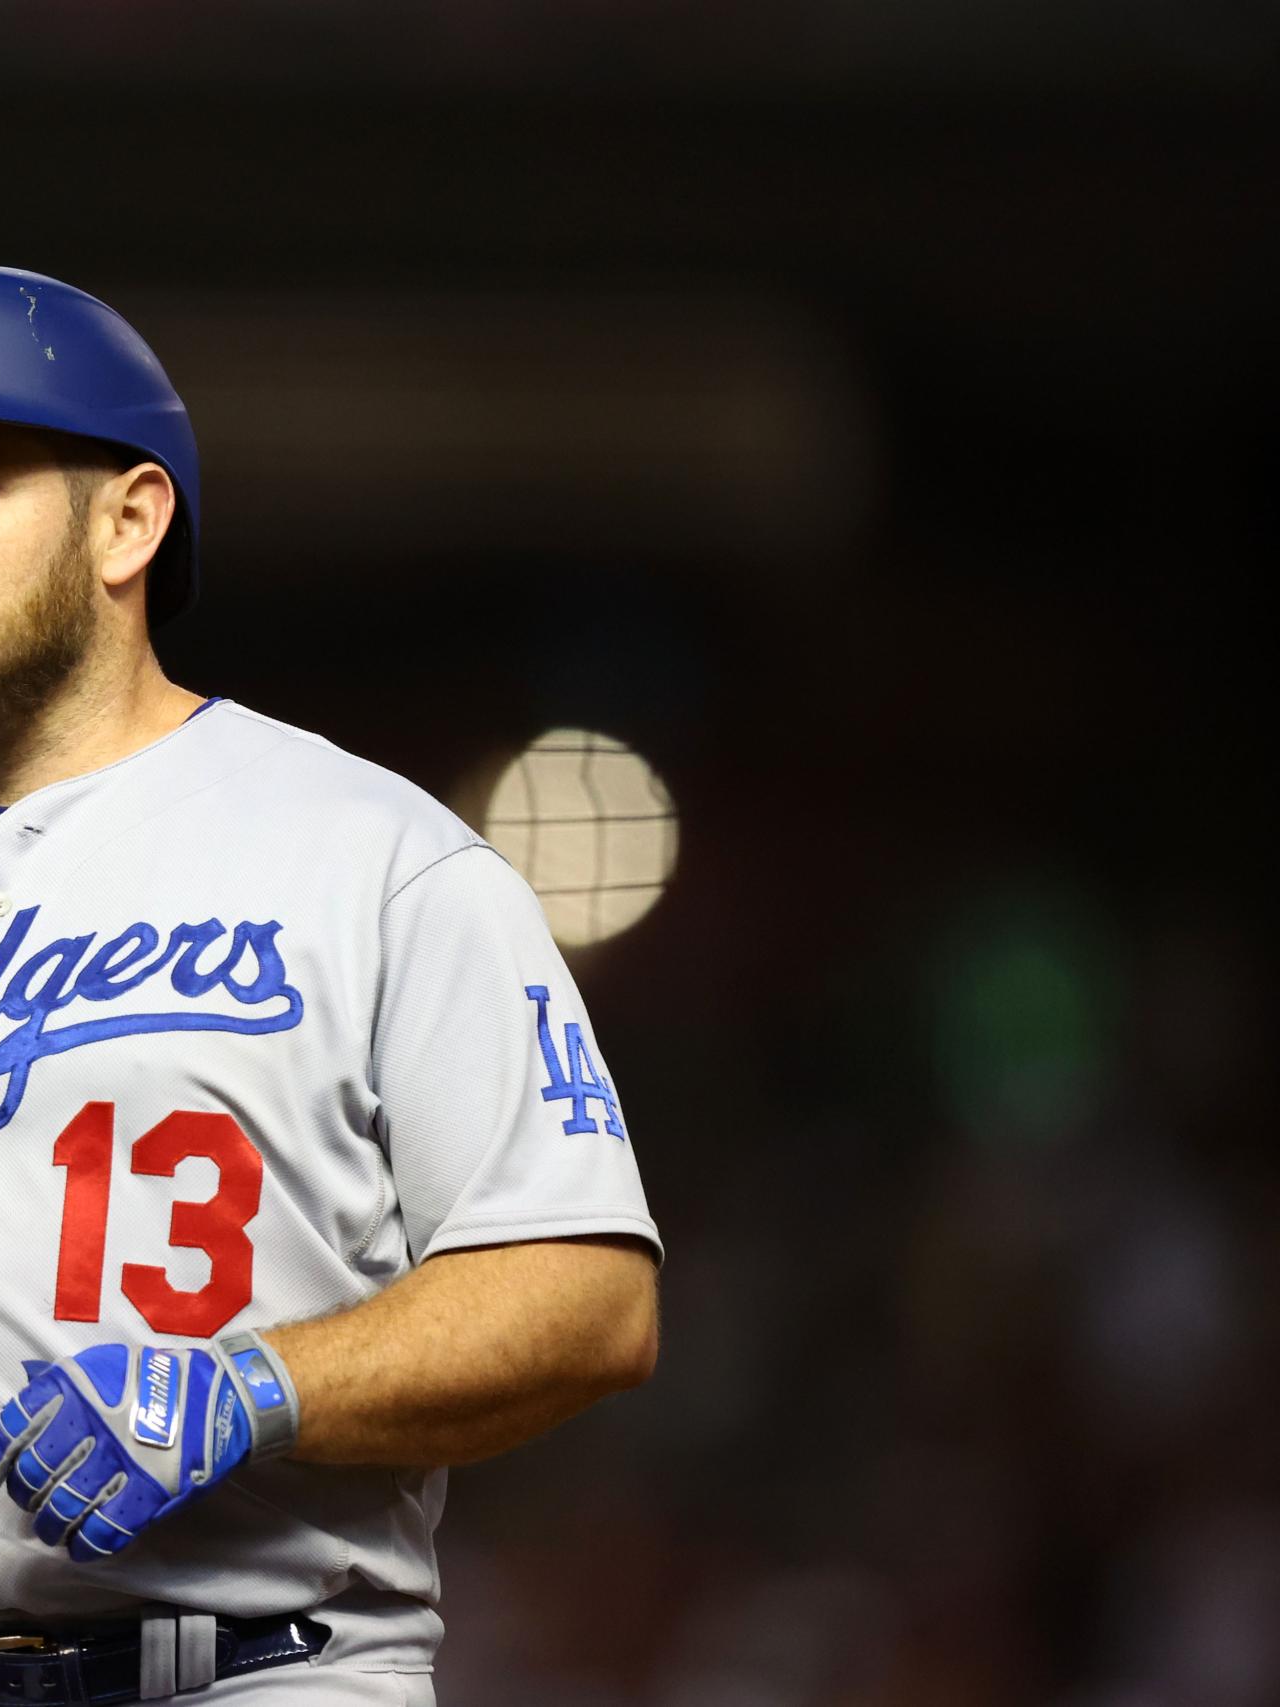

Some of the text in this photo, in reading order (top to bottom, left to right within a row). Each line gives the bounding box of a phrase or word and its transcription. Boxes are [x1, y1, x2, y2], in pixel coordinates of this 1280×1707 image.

[525, 985, 625, 1142] LA
[53, 1101, 263, 1338] 13
[138, 1352, 171, 1437] Franklin
